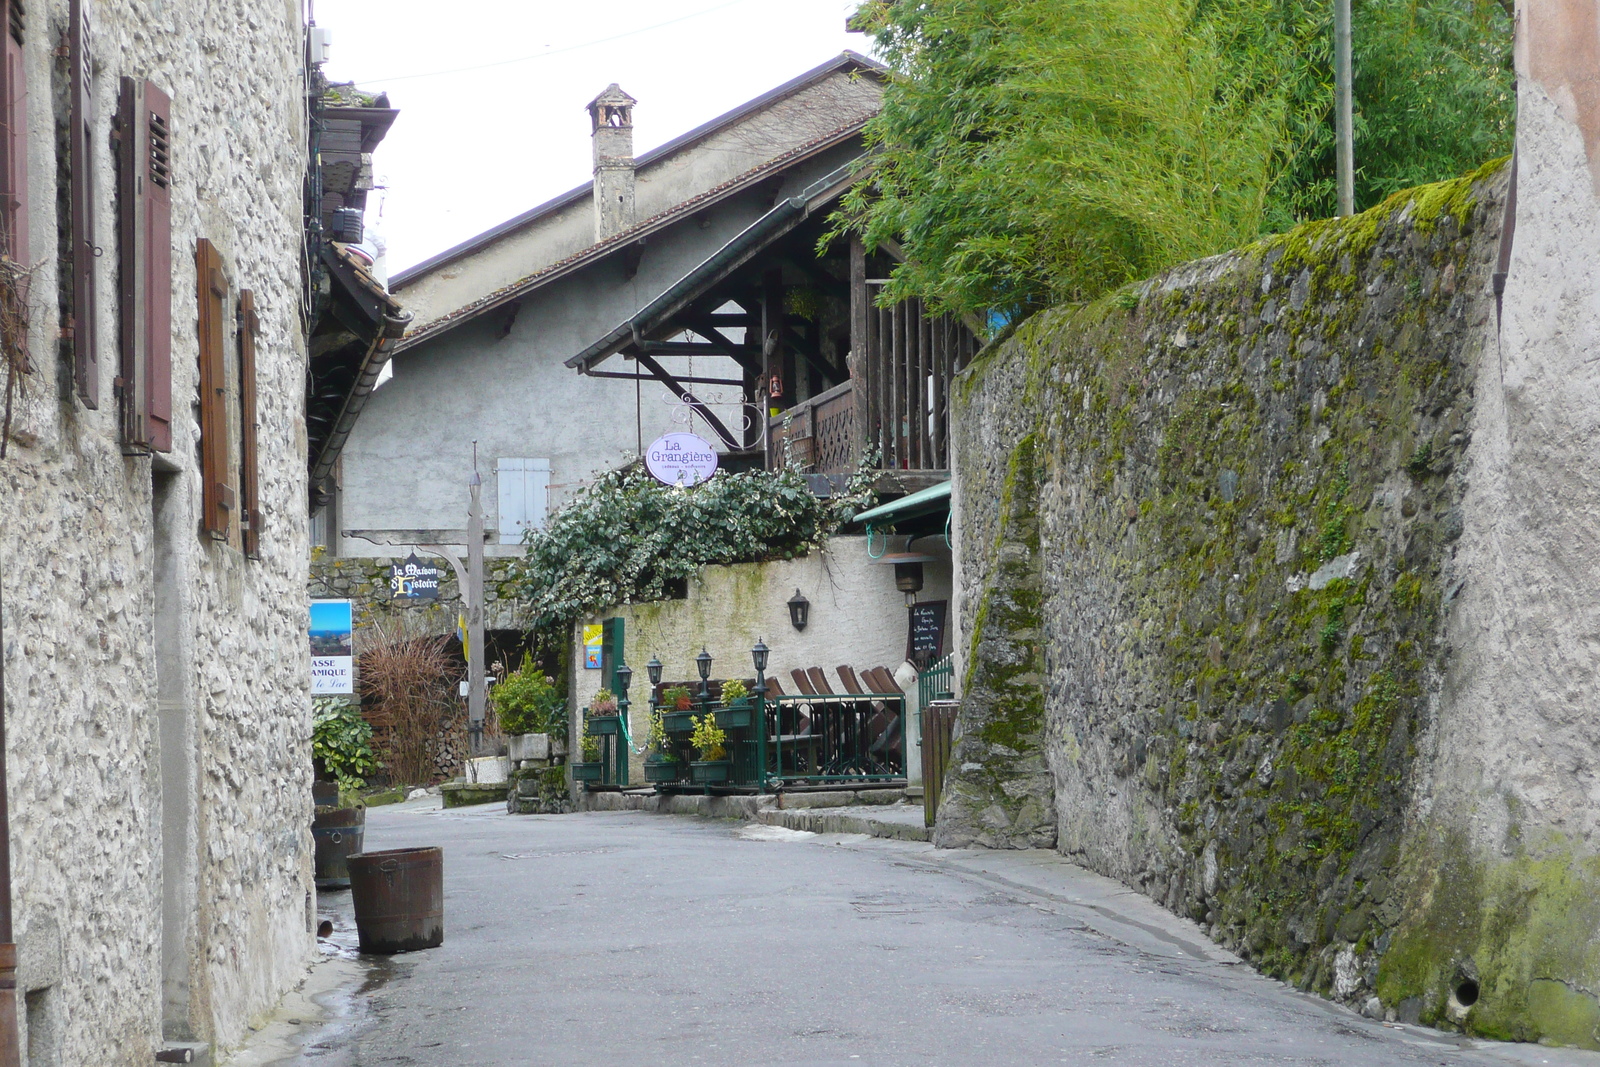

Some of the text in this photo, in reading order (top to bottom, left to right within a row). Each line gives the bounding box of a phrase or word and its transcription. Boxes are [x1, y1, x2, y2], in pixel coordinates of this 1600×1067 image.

[664, 440, 681, 451] La
[651, 451, 712, 464] Grangière
[405, 563, 437, 577] Maison
[311, 669, 346, 677] AMIQUE
